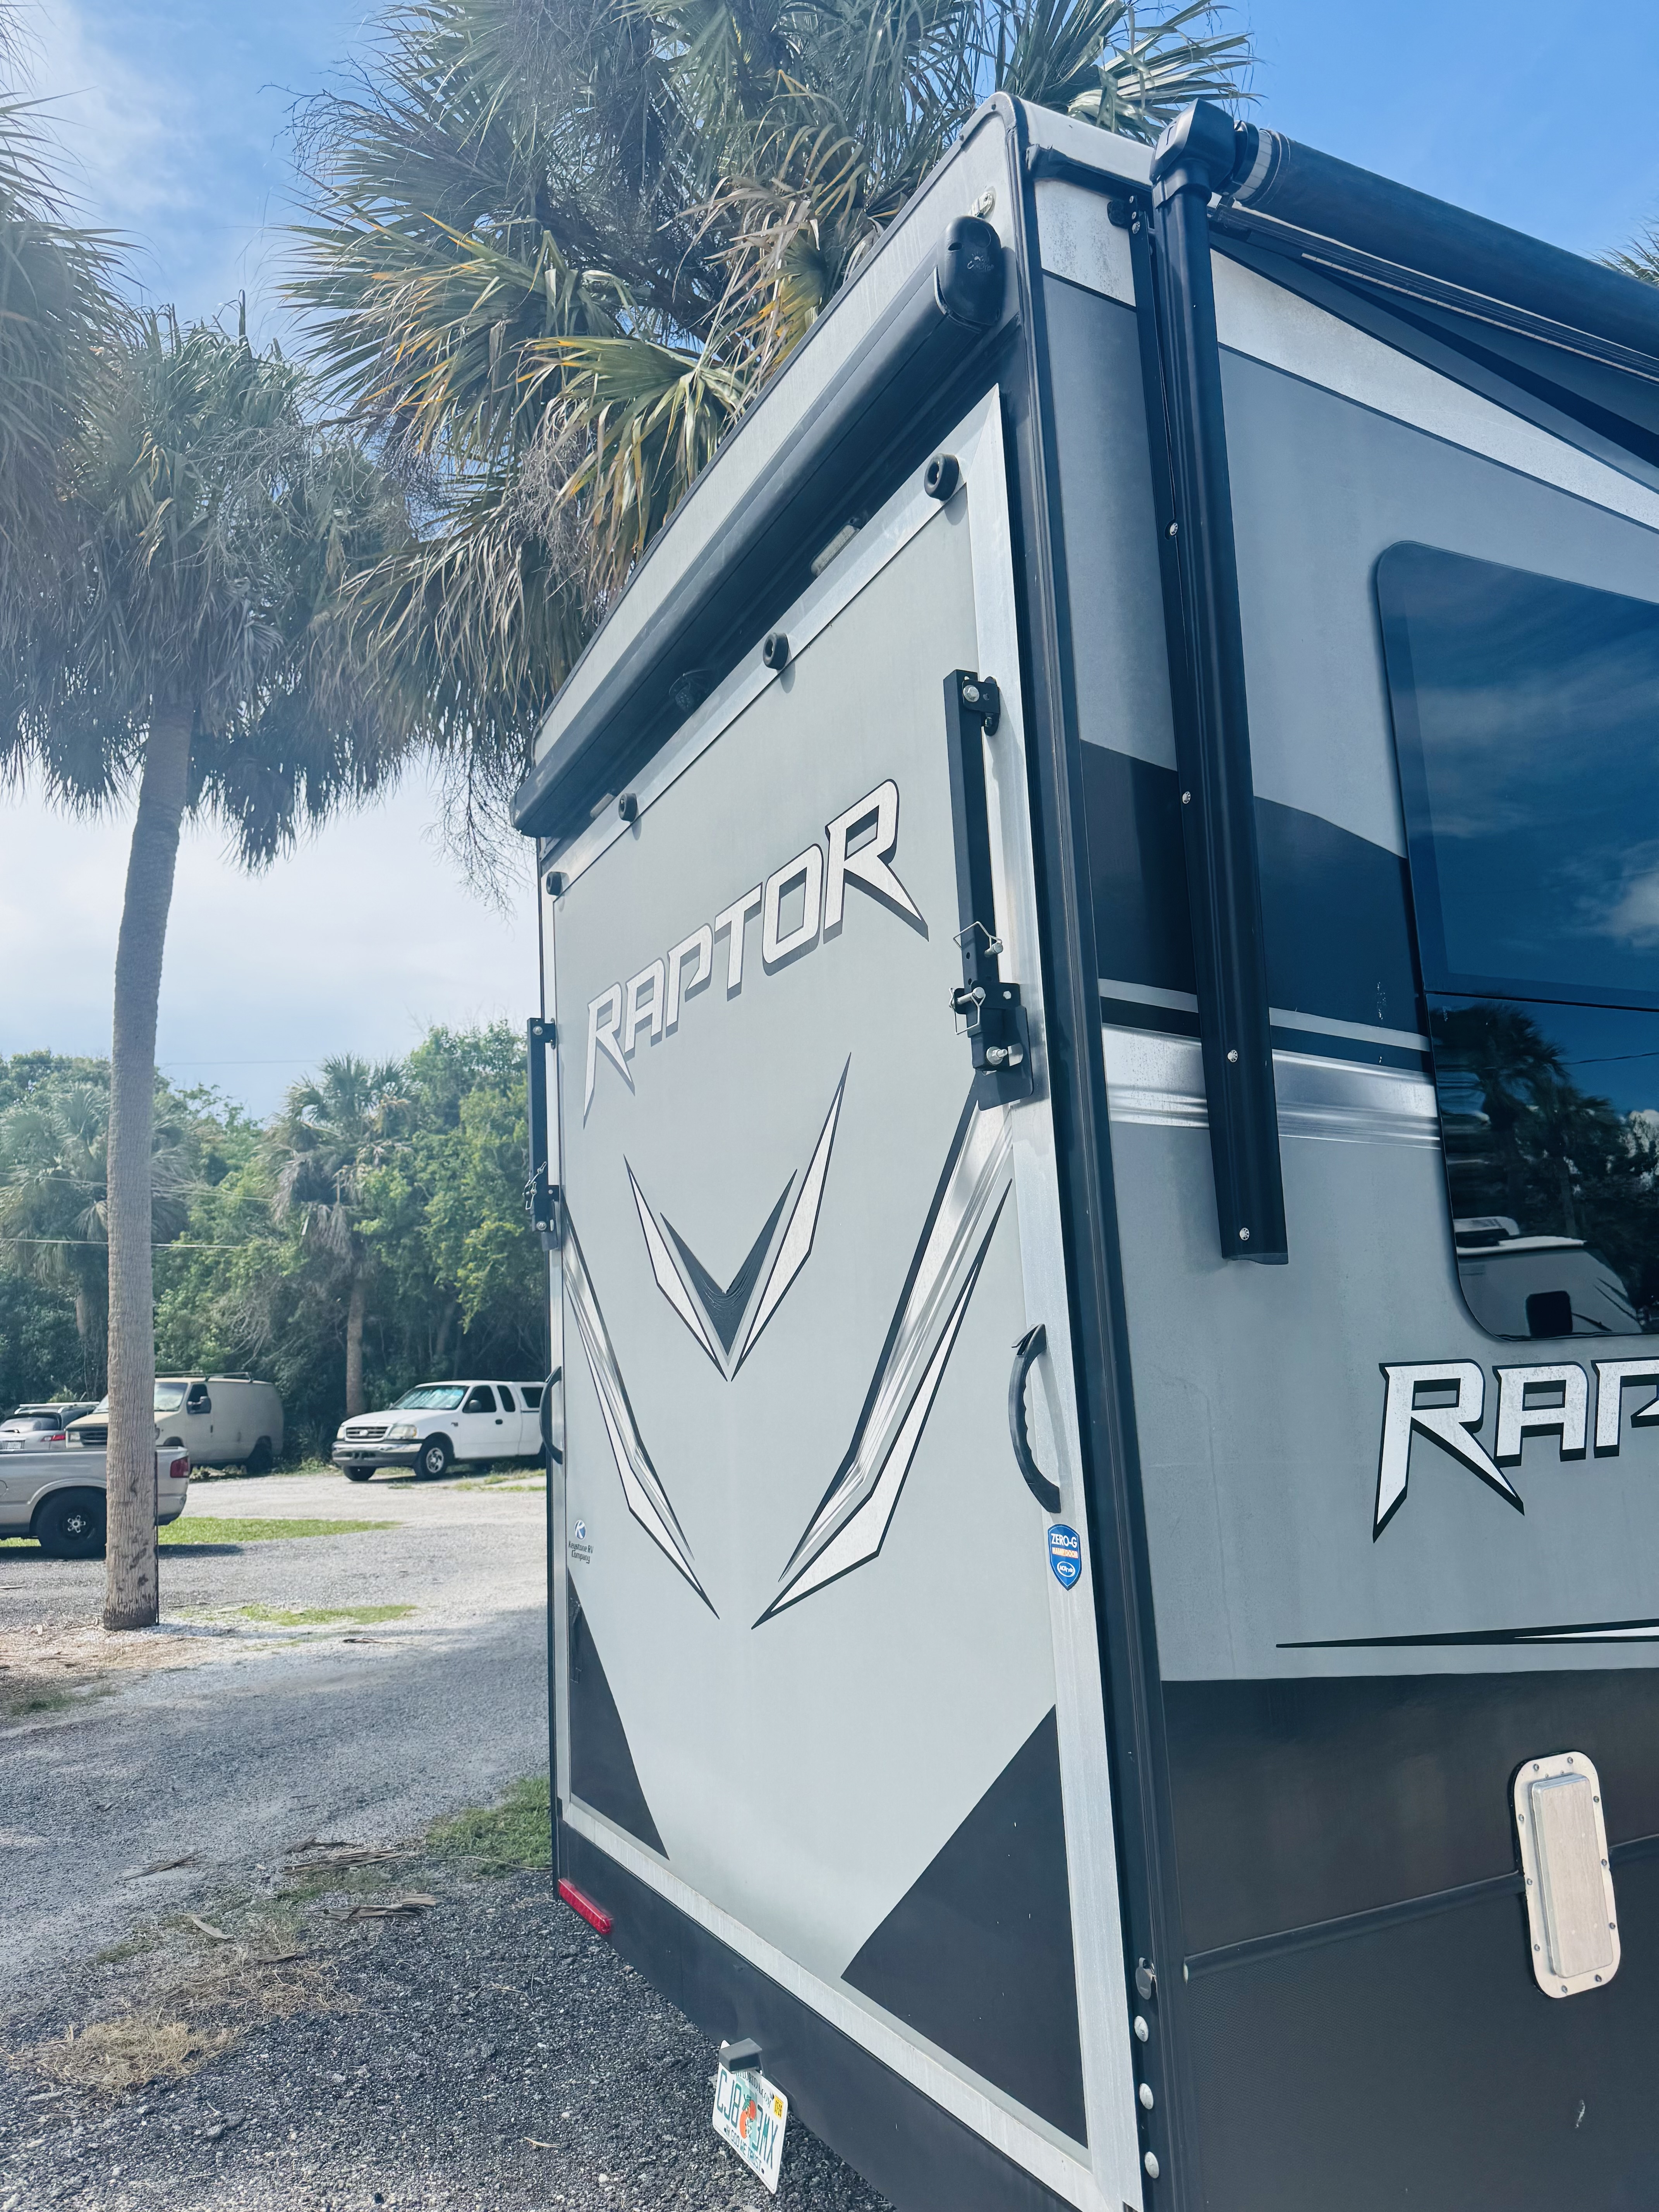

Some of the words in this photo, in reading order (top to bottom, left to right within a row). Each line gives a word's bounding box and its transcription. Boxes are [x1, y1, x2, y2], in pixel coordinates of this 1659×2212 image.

[584, 778, 929, 1130] RAPTOR
[568, 1540, 587, 1553] Keystone
[587, 1545, 594, 1554] RV
[1051, 1533, 1077, 1548] ZERO-G
[572, 1549, 591, 1564] Company
[730, 2130, 740, 2148] GOD
[740, 2139, 747, 2156] WE
[748, 2146, 762, 2171] TRUST
[750, 2104, 778, 2170] 3MX
